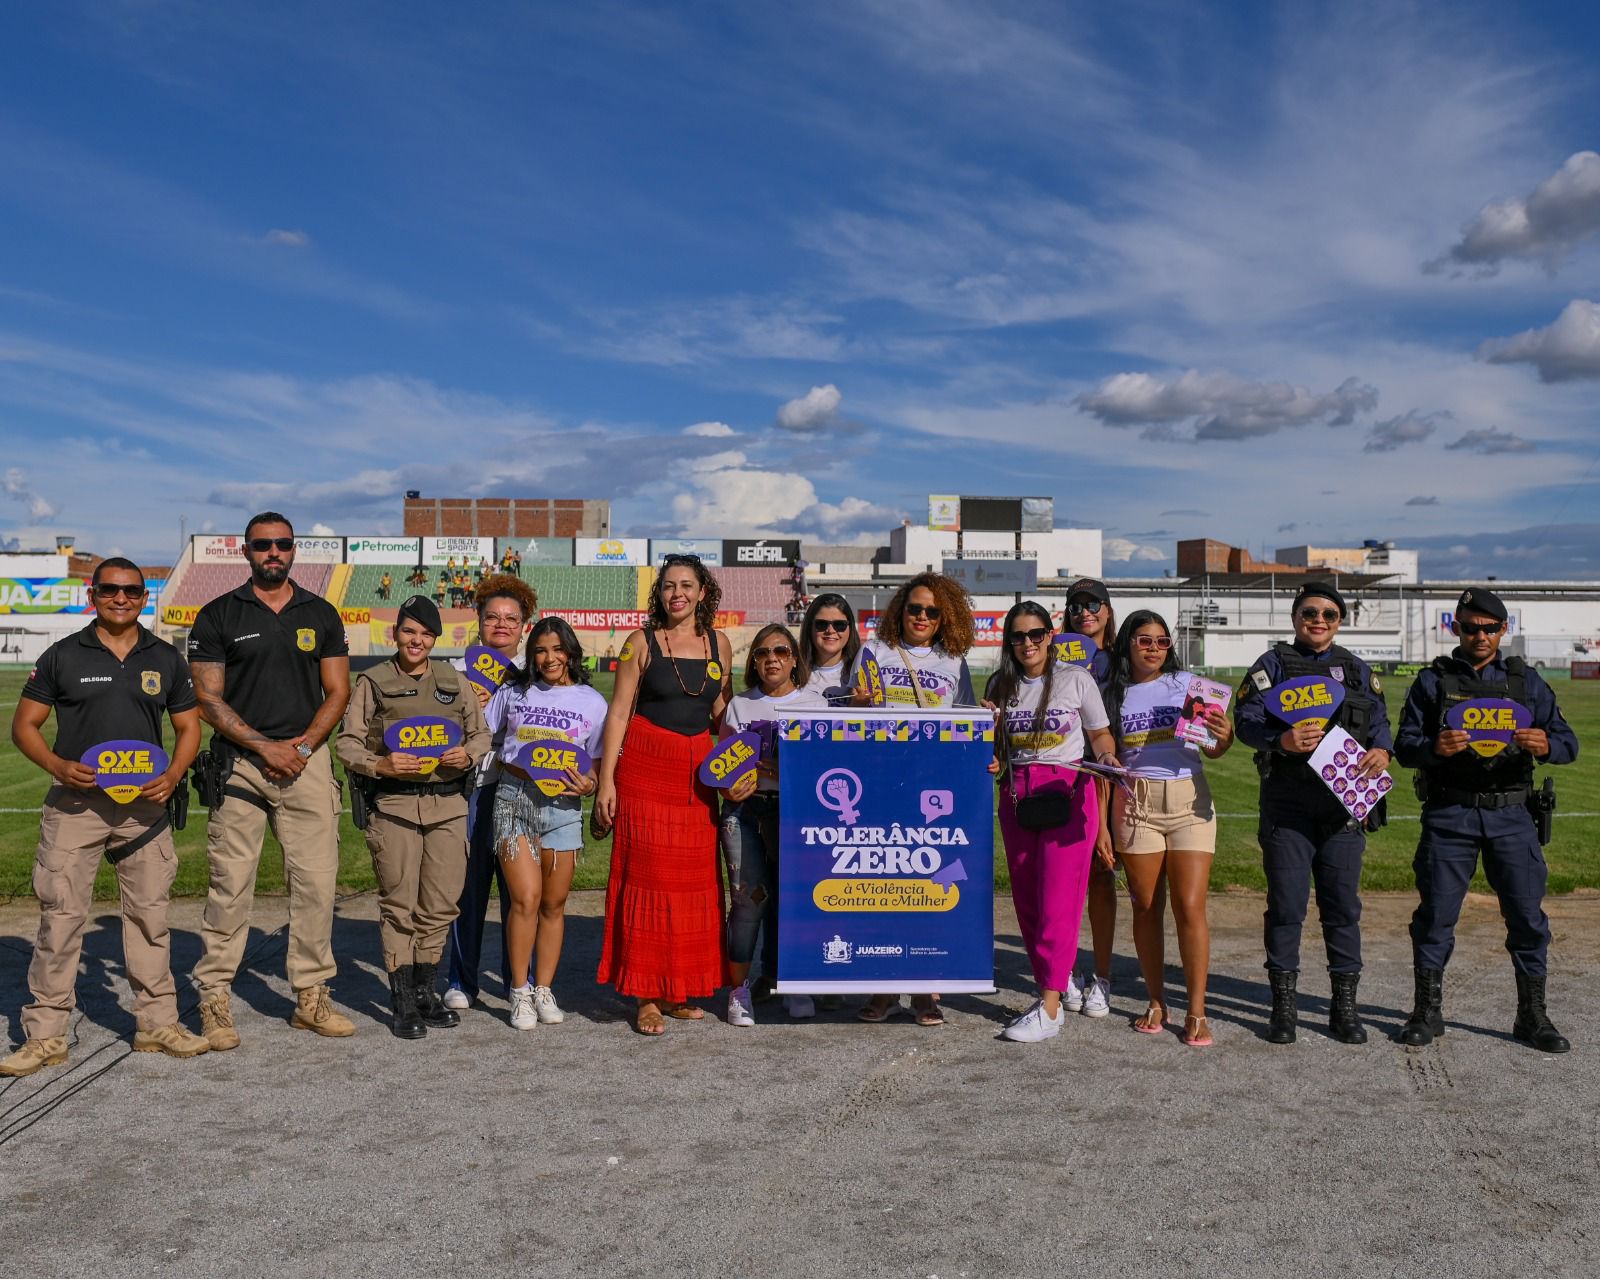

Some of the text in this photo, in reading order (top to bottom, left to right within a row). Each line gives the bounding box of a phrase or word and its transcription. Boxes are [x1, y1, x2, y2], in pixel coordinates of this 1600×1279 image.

[362, 540, 418, 552] Petromed
[167, 607, 182, 621] NO
[586, 612, 605, 627] NOS
[606, 612, 636, 627] VENCE
[1055, 640, 1086, 658] XE,
[1279, 683, 1332, 706] OXE,
[514, 704, 584, 722] TOLERÂNCIA
[1281, 704, 1293, 713] ME
[1463, 707, 1517, 725] OXE,
[522, 713, 571, 730] ZERO
[1007, 717, 1061, 733] ZEO
[1462, 722, 1475, 730] ME
[399, 724, 449, 743] OXE,
[97, 750, 154, 769] OXE,
[532, 746, 579, 767] OXE,
[709, 739, 752, 775] OXE,
[97, 767, 111, 775] ME
[800, 822, 970, 846] TOLERÂNCIA
[831, 846, 942, 875] ZERO
[843, 882, 925, 895] à Violência
[822, 895, 948, 907] Contra a Mulher
[855, 946, 903, 955] JUAZEIRO
